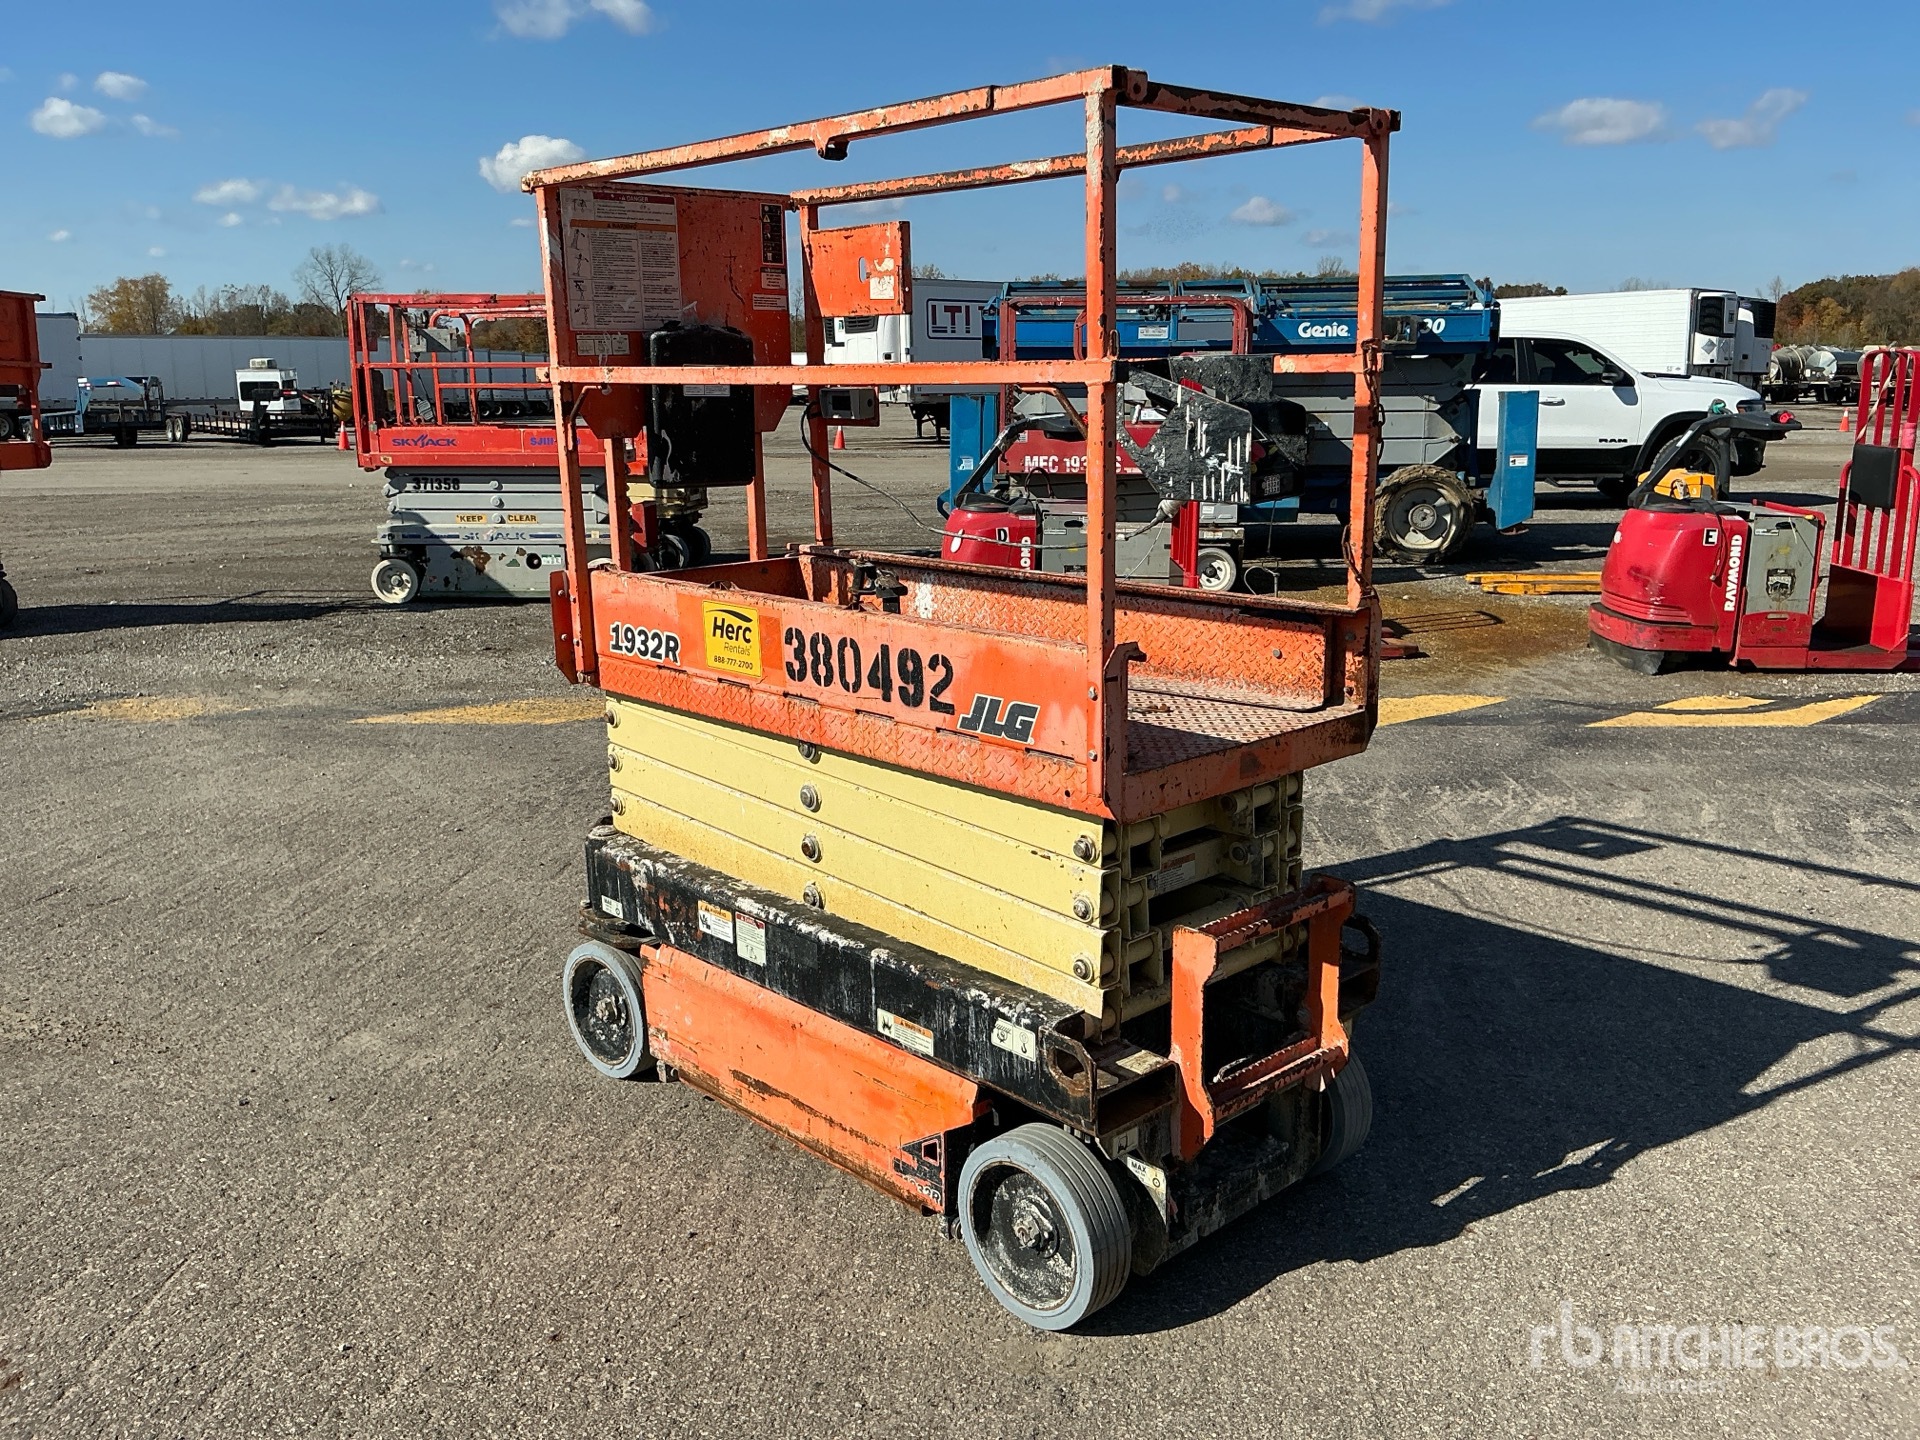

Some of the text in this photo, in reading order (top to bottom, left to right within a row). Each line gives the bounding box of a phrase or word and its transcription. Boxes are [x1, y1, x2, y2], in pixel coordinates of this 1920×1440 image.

[298, 322, 349, 338] Genie
[392, 434, 457, 448] SKYJACK
[1025, 455, 1058, 473] MEC
[412, 478, 461, 491] 371358
[459, 514, 537, 523] KEEP CLEAR
[997, 529, 1008, 543] D
[1705, 529, 1717, 545] E
[1724, 535, 1743, 611] RAYMOND
[712, 617, 752, 644] Herc
[610, 622, 680, 664] 1932R
[713, 655, 753, 670] 888-777-2700
[785, 627, 955, 715] 380492
[957, 693, 1041, 743] JLG
